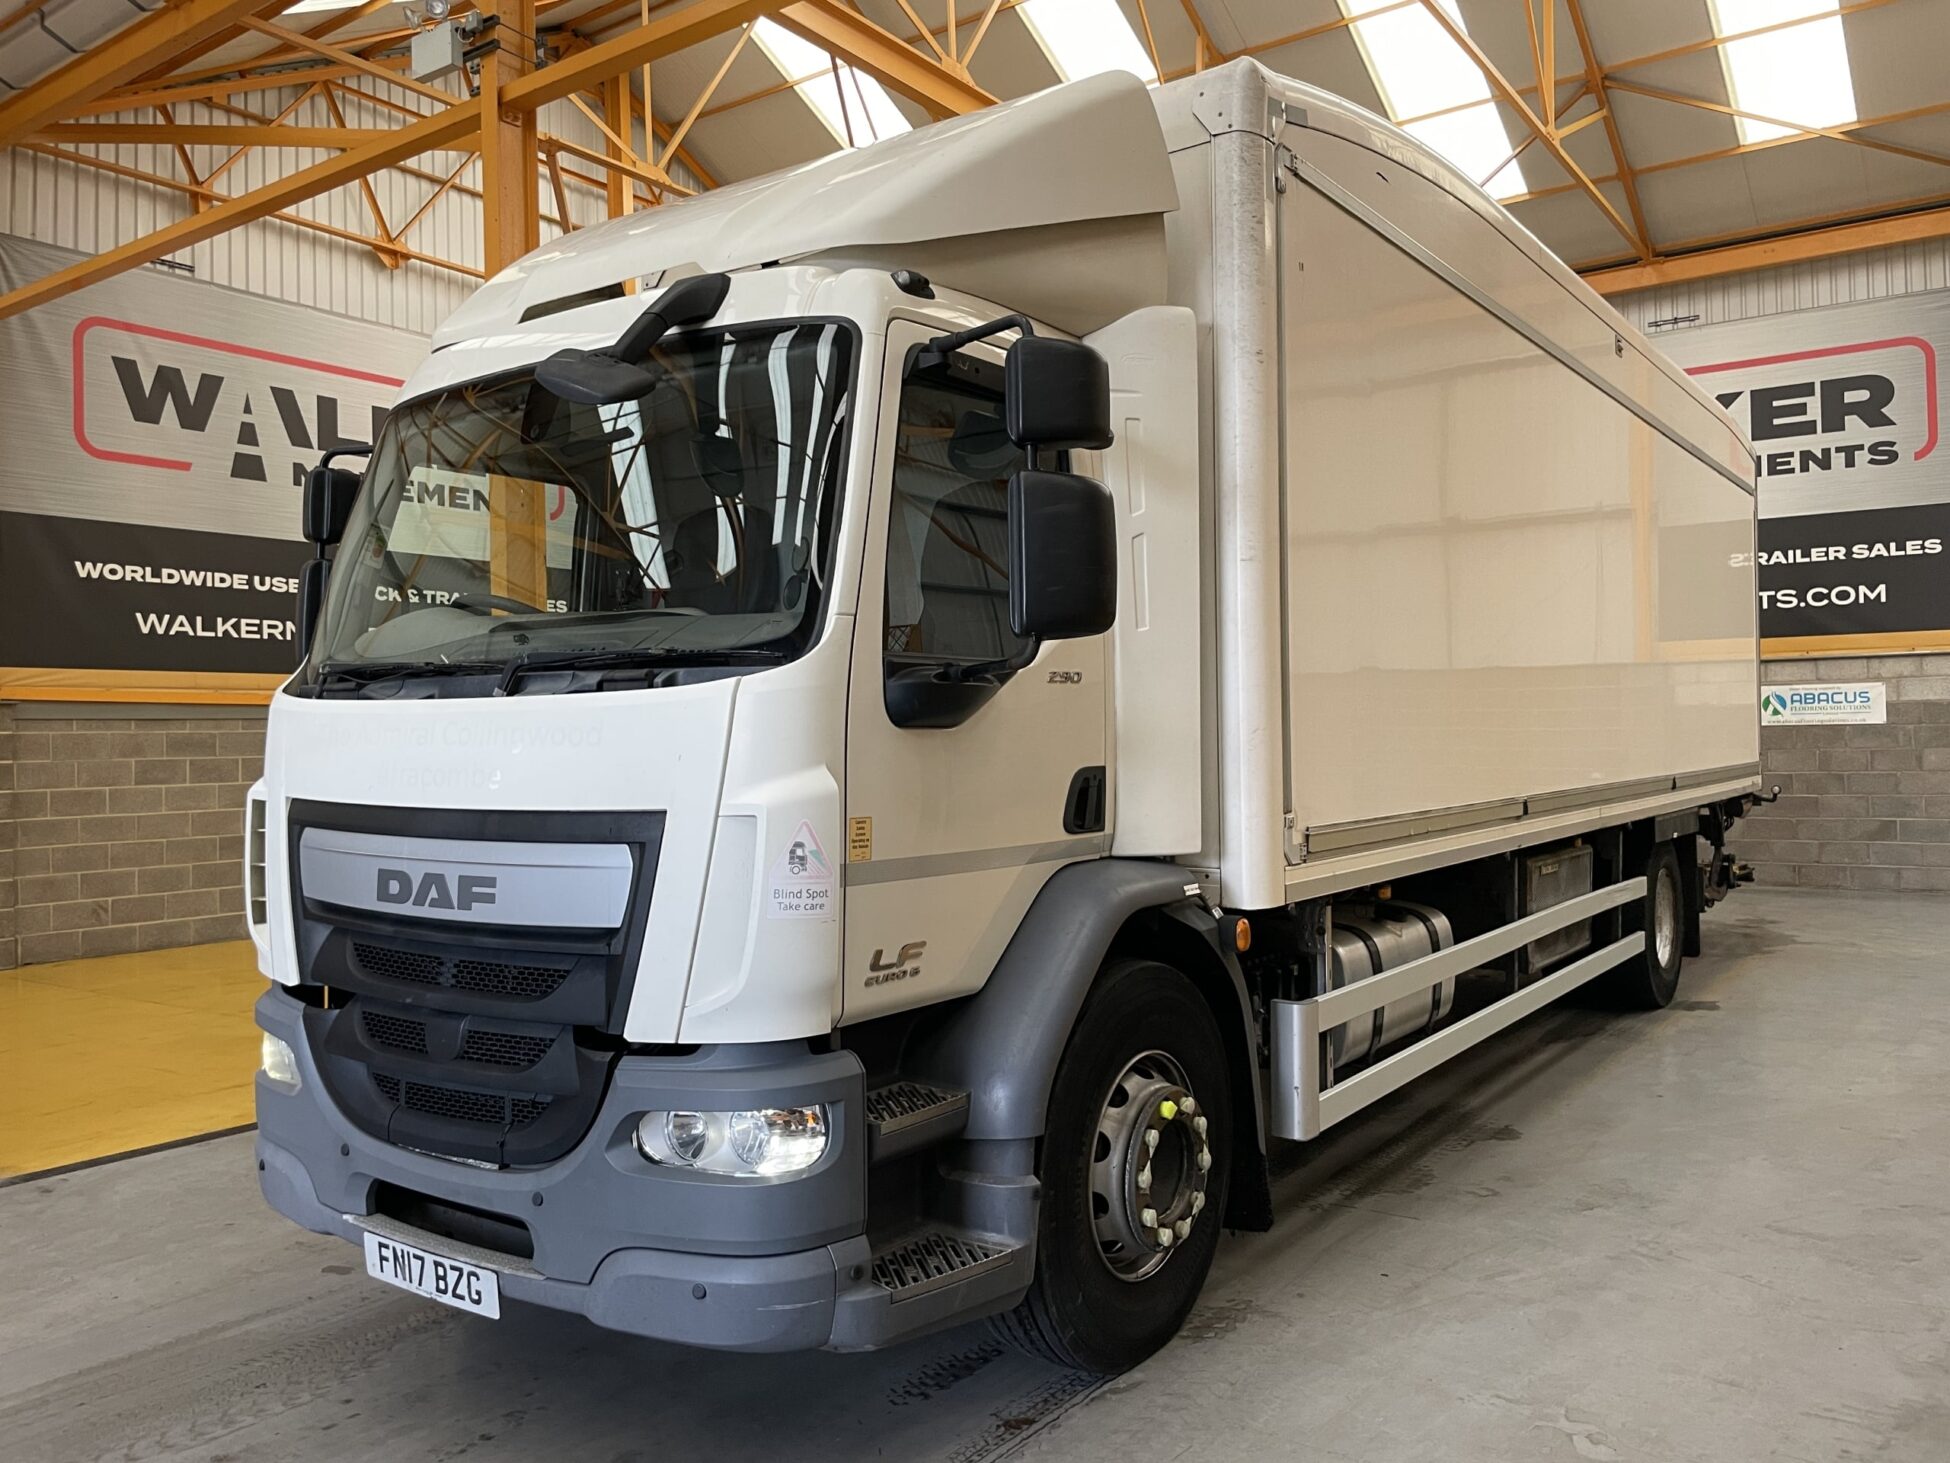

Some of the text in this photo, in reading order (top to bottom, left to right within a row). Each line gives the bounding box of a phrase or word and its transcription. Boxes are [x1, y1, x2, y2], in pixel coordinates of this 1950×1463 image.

[1715, 374, 1897, 441] ER
[1756, 440, 1899, 477] ENTS
[1851, 538, 1943, 559] SALES
[74, 560, 249, 590] WORLDWIDE
[407, 588, 420, 603] &
[1759, 583, 1887, 610] TS.COM
[1790, 690, 1871, 705] ABACUS
[1830, 703, 1872, 711] SOLUTIONS
[376, 867, 498, 911] DAF
[773, 887, 829, 901] Blind Spot
[777, 902, 825, 911] Take care
[869, 940, 927, 972] LF
[864, 965, 921, 988] EURO 6
[378, 1241, 482, 1305] FN17 BZG
